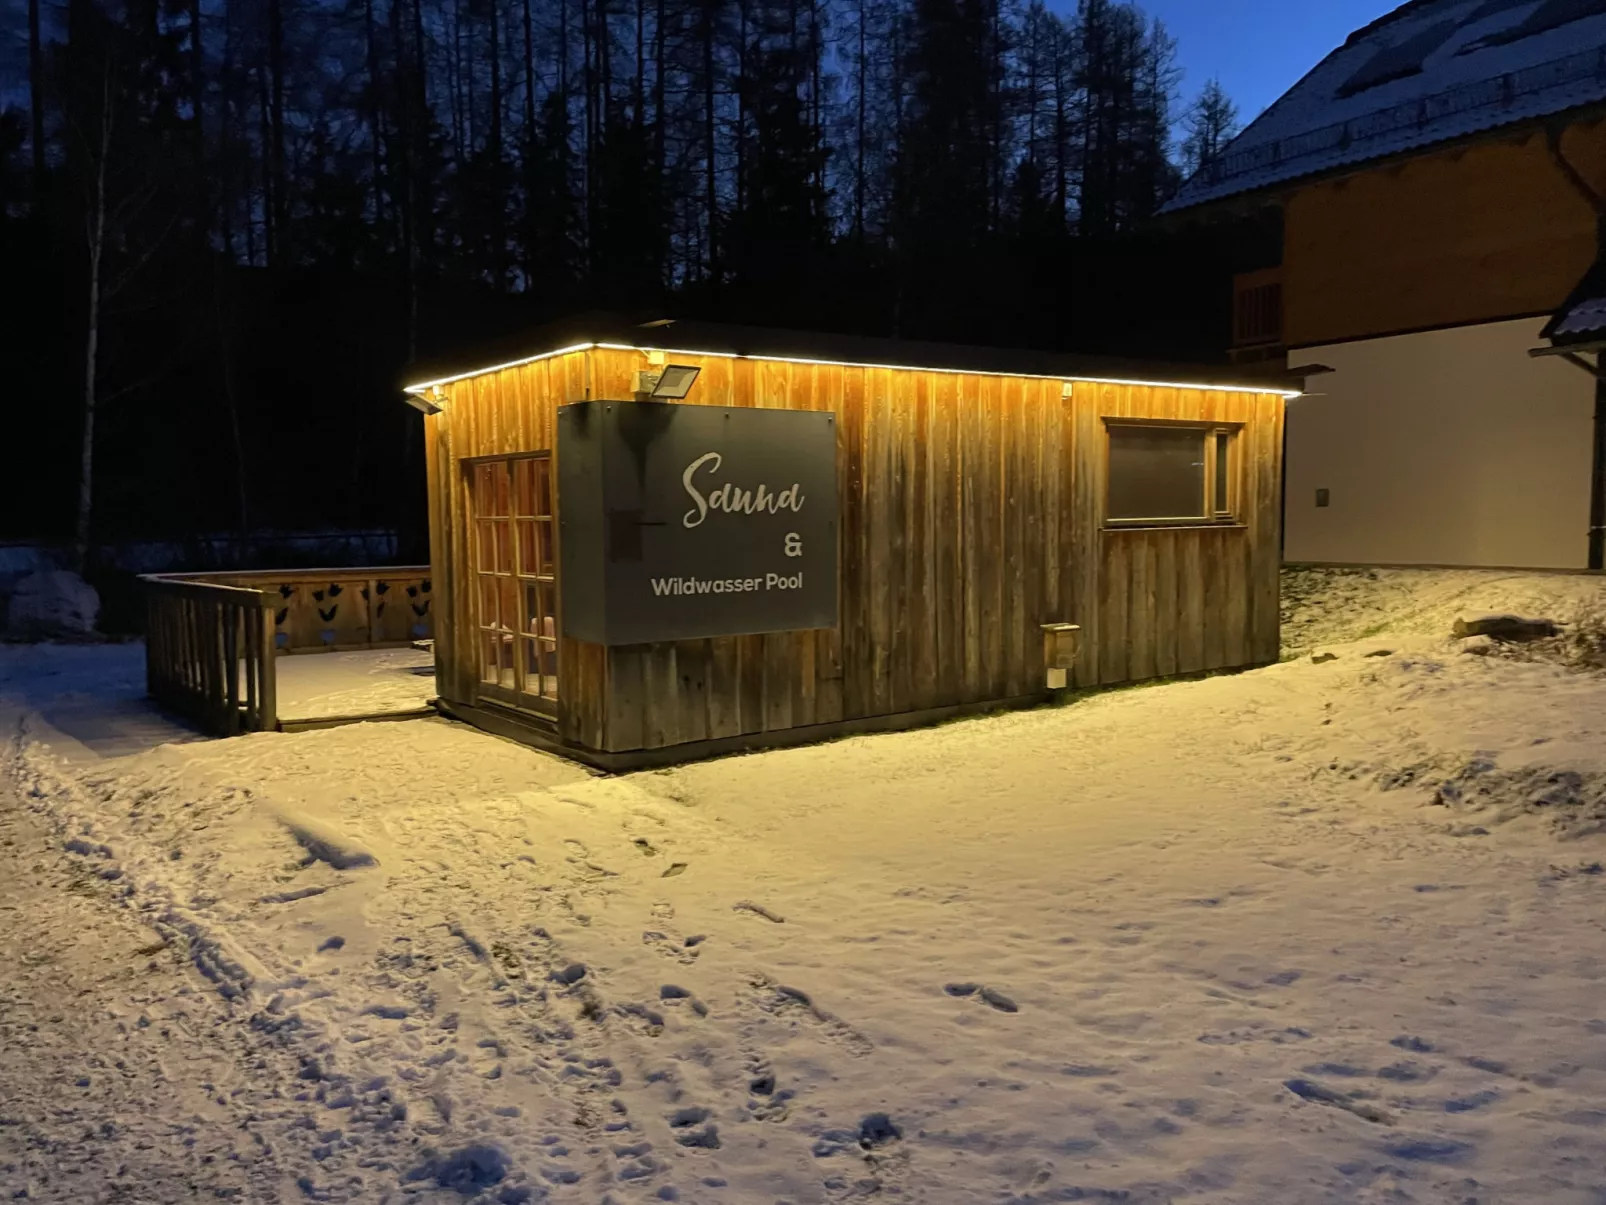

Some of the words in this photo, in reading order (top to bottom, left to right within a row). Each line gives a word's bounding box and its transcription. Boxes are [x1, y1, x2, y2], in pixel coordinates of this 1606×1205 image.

[682, 452, 805, 528] Sauna
[784, 533, 802, 557] &
[651, 577, 763, 596] Wildwasser
[765, 572, 803, 590] Pool
